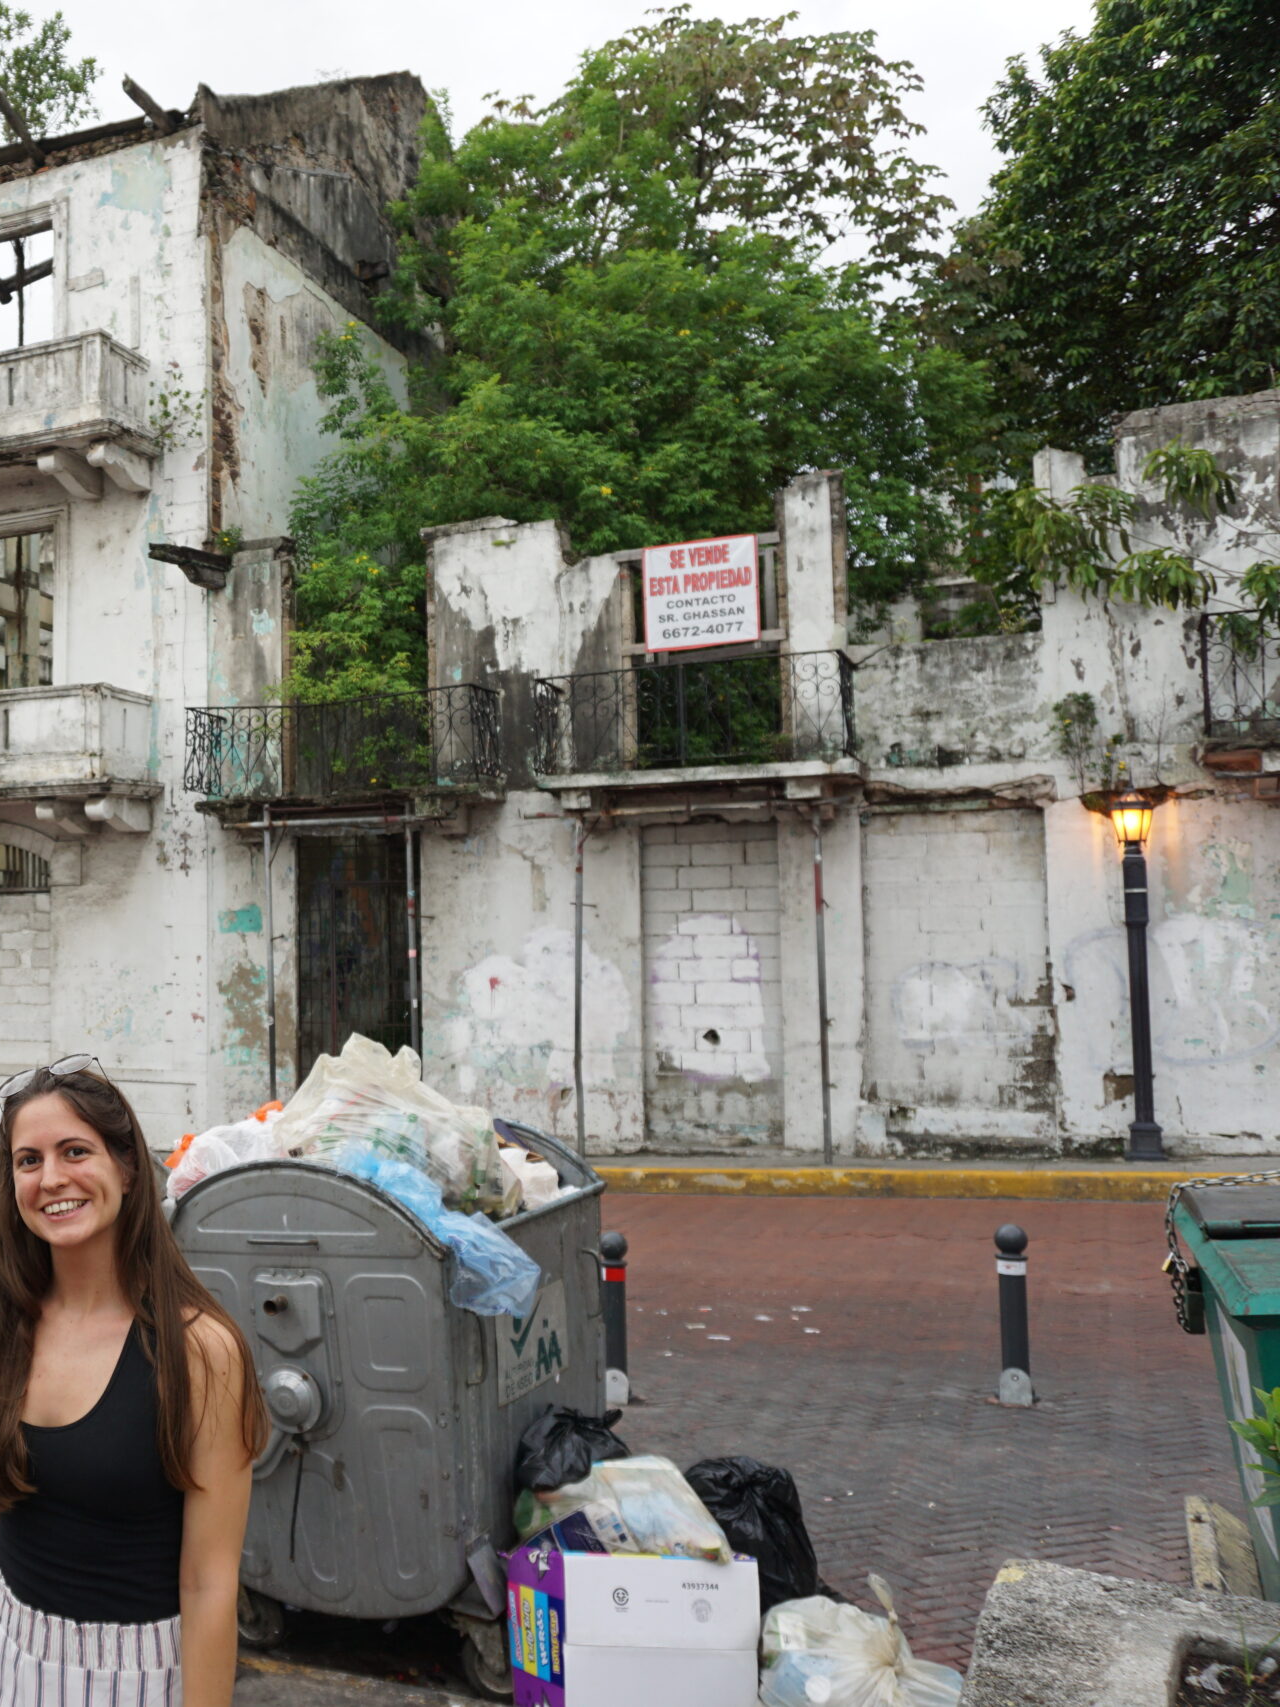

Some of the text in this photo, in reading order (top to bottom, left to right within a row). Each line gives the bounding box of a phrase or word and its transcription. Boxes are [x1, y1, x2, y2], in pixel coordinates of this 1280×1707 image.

[669, 544, 730, 570] SE VENDE
[649, 566, 753, 597] ESTA PROPIEDAD
[666, 593, 736, 610] CONTACTO
[658, 606, 746, 624] SR. GHASSAN
[662, 621, 744, 640] 6672-4077
[535, 1330, 563, 1381] AA
